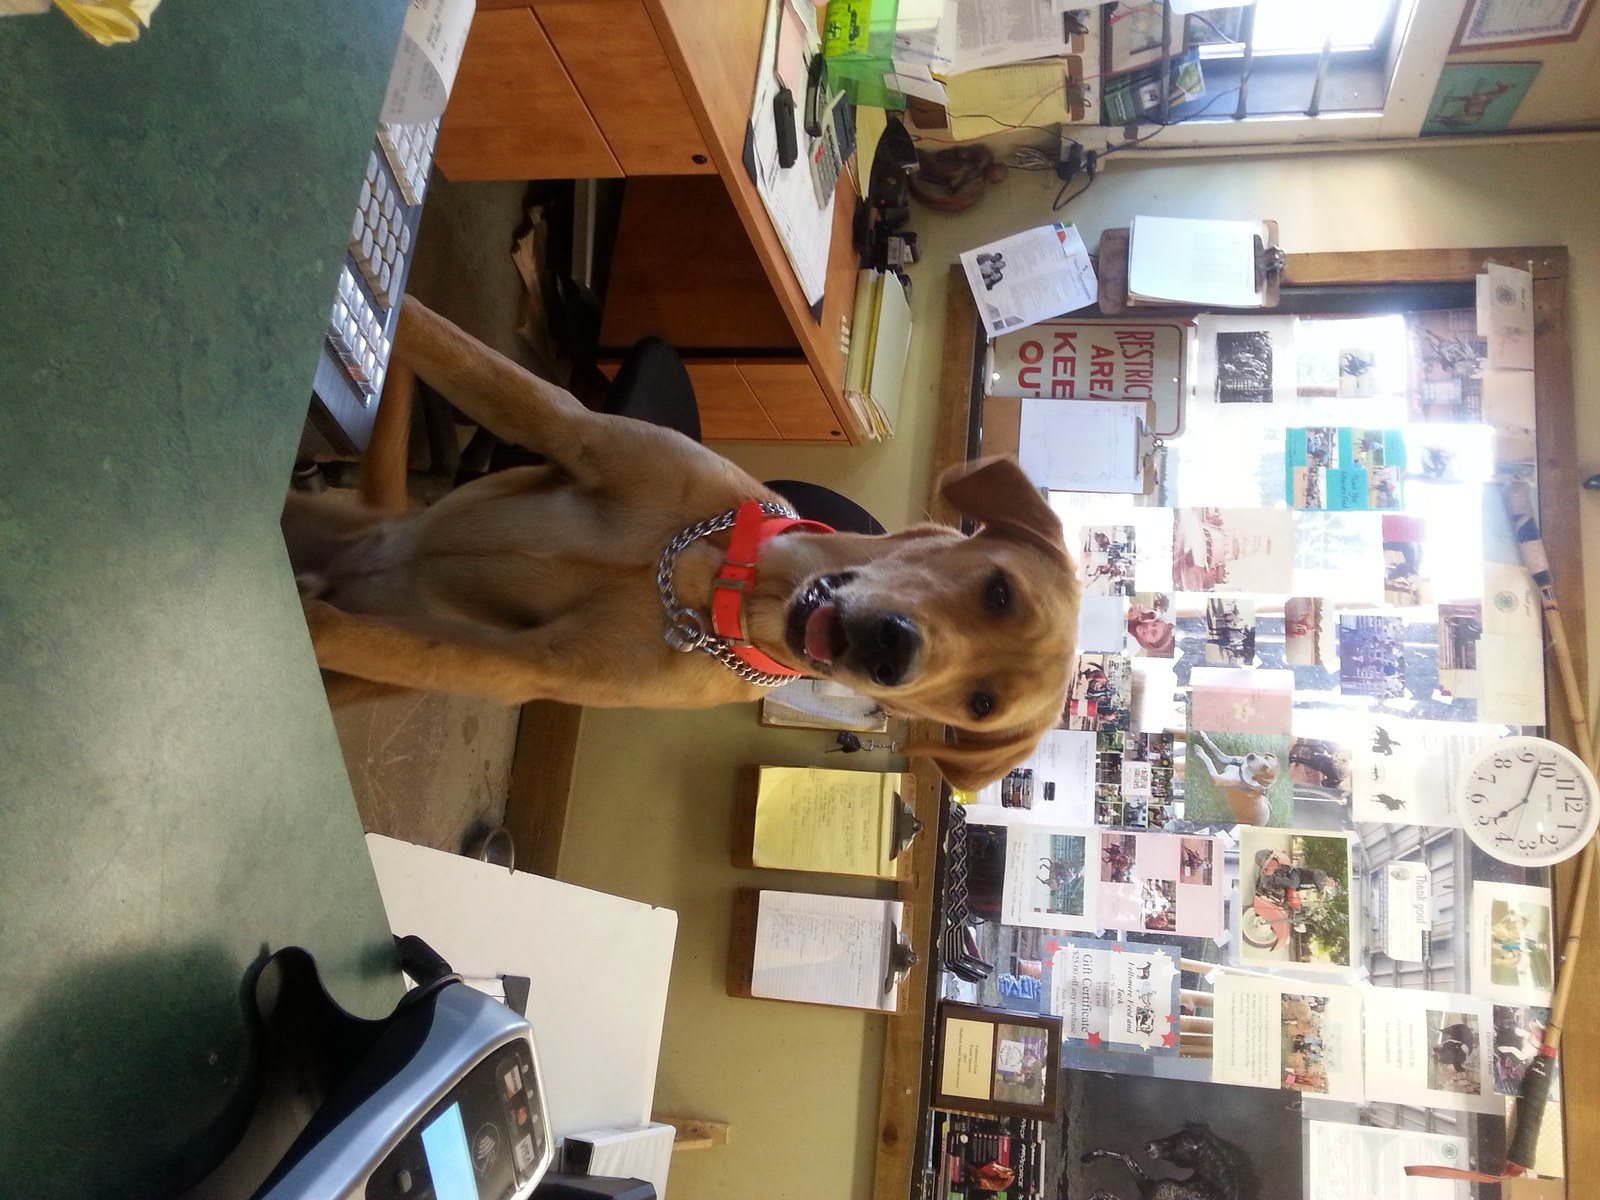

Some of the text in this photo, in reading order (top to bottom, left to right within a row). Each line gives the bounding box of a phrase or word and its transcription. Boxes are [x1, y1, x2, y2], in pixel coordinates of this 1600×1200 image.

[1494, 758, 1512, 769] 8
[1516, 752, 1535, 763] 9
[1538, 761, 1557, 779] 10
[1478, 774, 1496, 784] 7
[1556, 778, 1575, 791] 11
[1471, 793, 1490, 804] 6
[1564, 795, 1583, 813] 12
[1478, 815, 1498, 826] 5
[1495, 832, 1514, 844] 4
[1540, 834, 1558, 845] 2
[1518, 839, 1537, 850] 3
[1415, 874, 1427, 902] Thank
[1071, 975, 1080, 987] off
[1081, 953, 1092, 1033] Gift Certificate
[1126, 961, 1135, 1034] Fellsmere Feed and
[1070, 1002, 1078, 1034] purchase
[520, 1141, 532, 1163] VISA
[1018, 1143, 1026, 1188] PROFORCE
